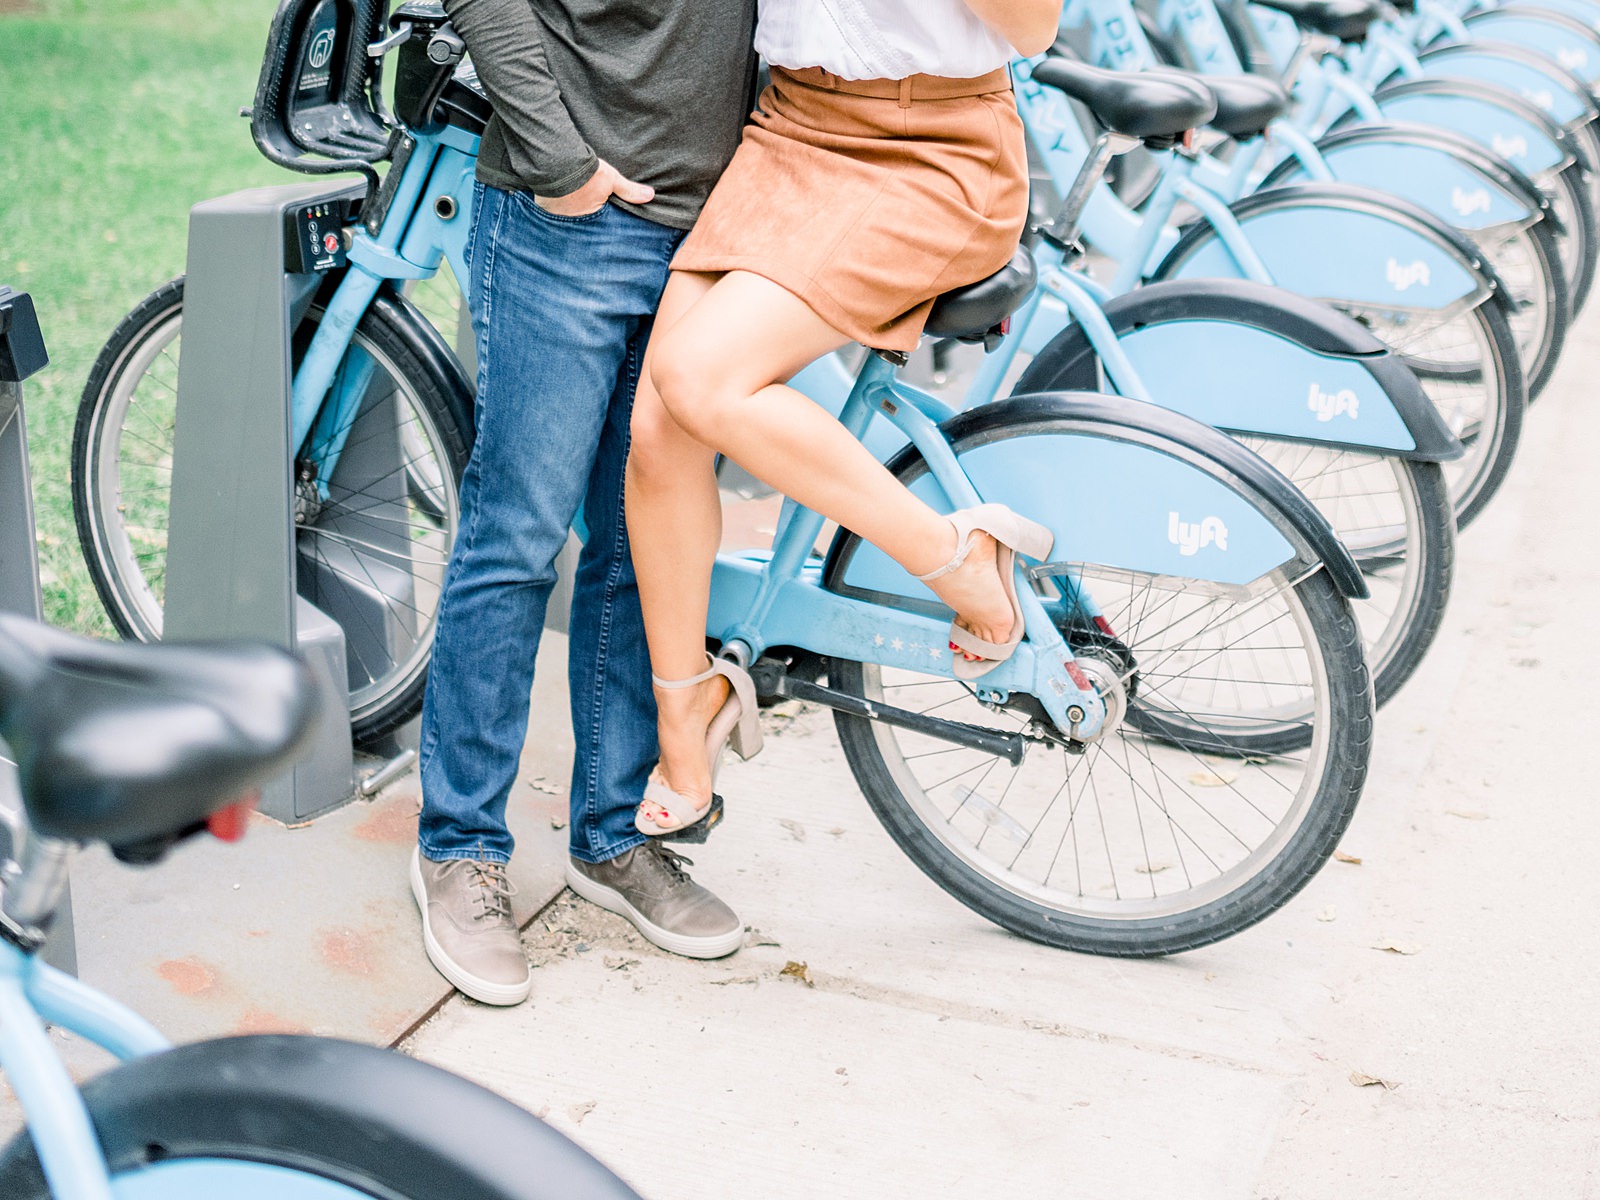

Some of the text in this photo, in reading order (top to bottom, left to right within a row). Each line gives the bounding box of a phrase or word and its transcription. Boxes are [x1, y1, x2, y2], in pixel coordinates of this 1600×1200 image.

[1386, 257, 1430, 291] lyft
[1307, 383, 1360, 422] lyft
[1168, 511, 1228, 556] lyft
